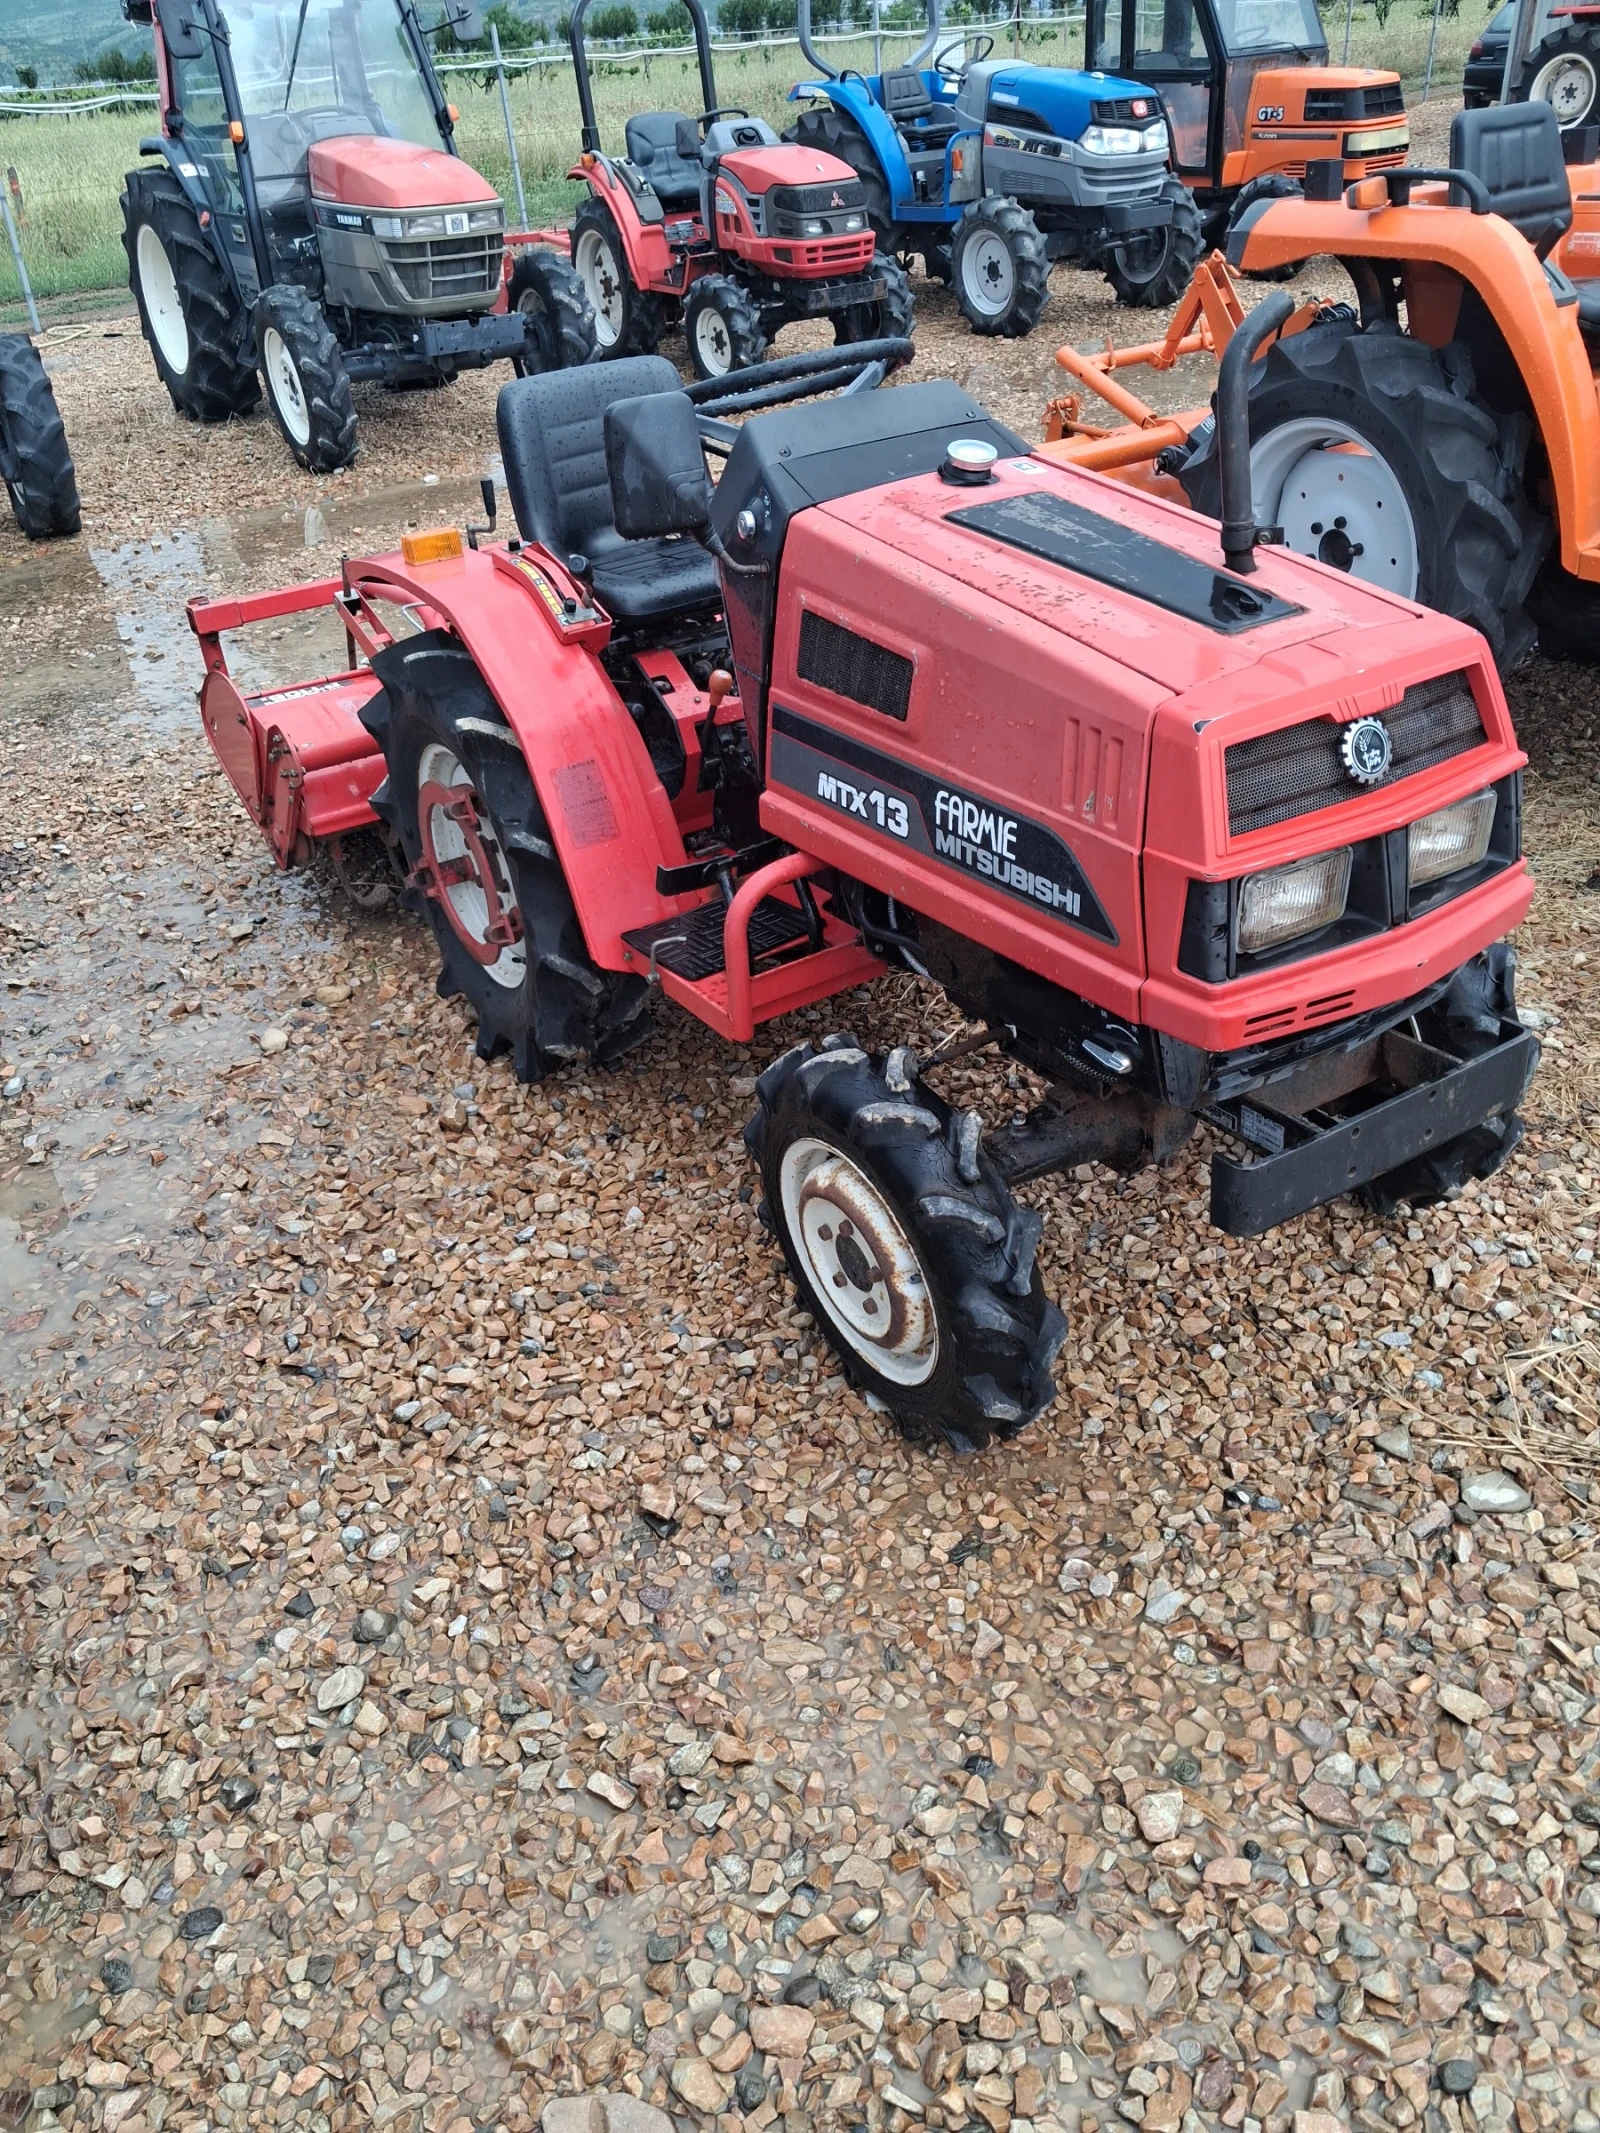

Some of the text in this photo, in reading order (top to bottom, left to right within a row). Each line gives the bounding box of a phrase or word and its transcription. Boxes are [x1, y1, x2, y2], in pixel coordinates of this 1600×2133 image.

[1258, 107, 1284, 121] GT-5
[1022, 138, 1062, 157] AT30
[336, 214, 363, 227] YANMAR
[817, 772, 909, 838] MTX13
[934, 790, 1018, 860] FARMIE
[935, 828, 1081, 917] MITSUBISHI
